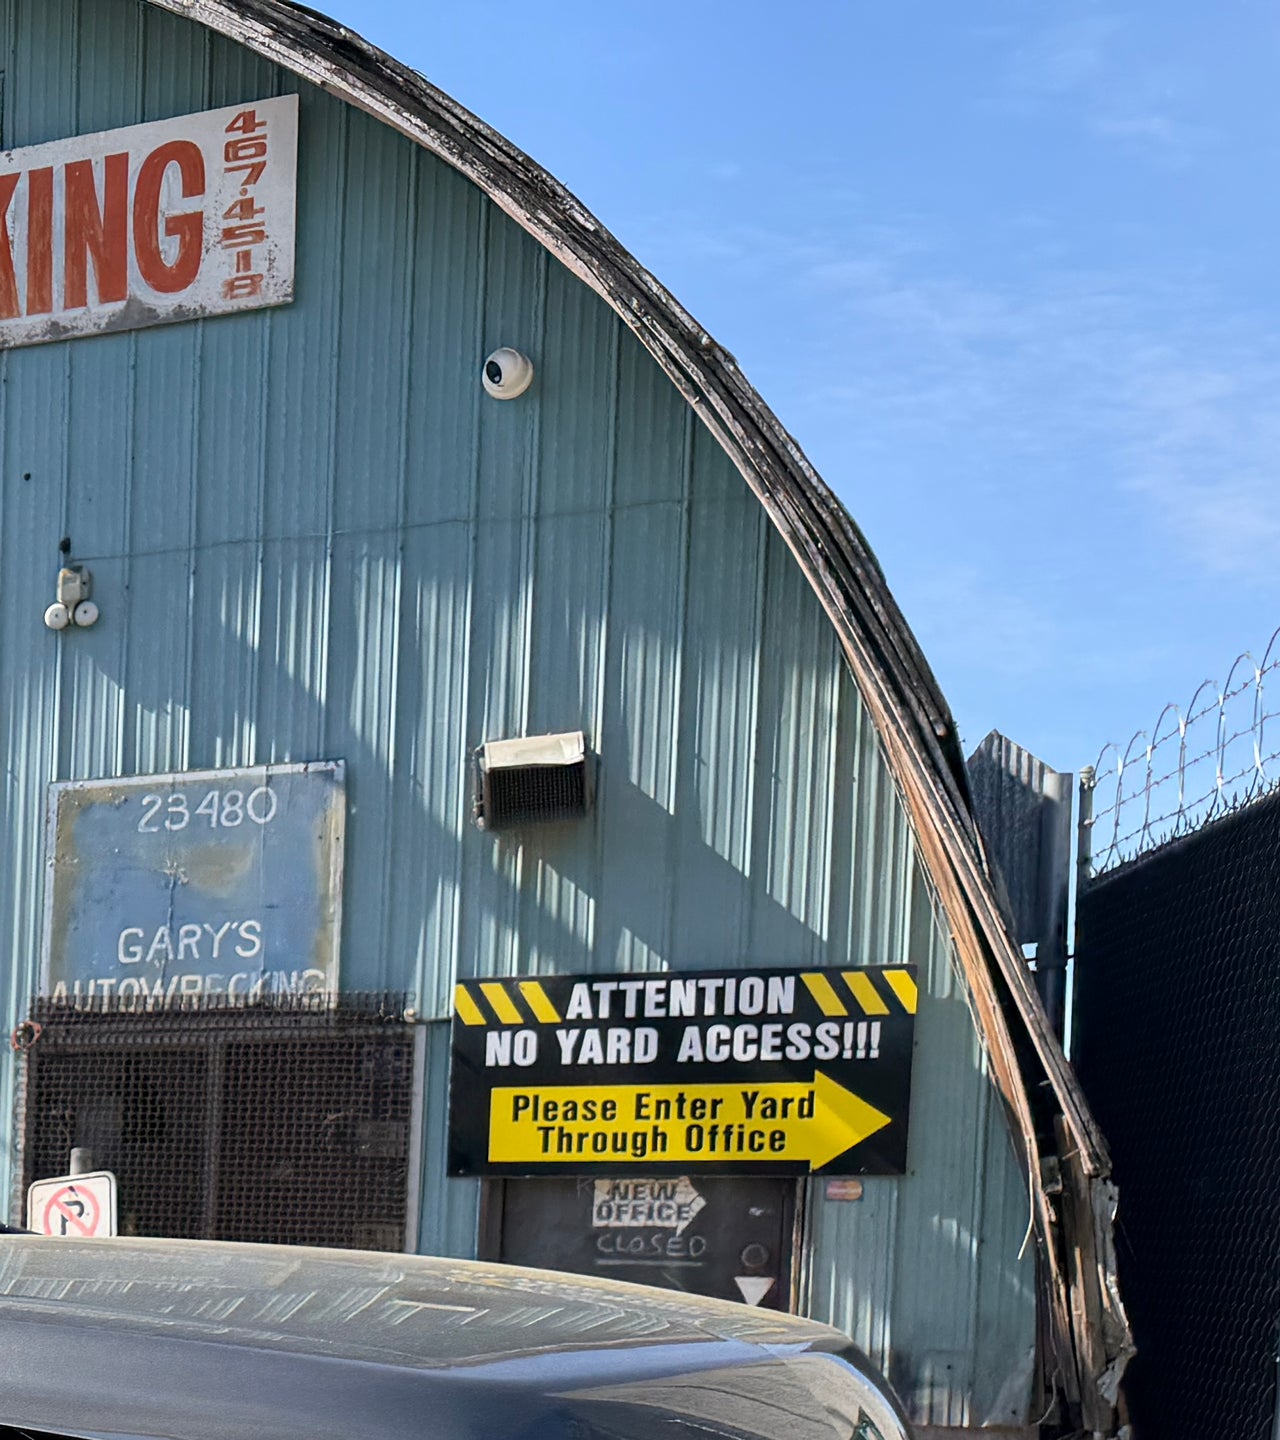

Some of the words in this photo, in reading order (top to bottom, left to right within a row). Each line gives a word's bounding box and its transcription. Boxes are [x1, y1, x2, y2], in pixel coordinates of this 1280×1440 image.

[138, 787, 278, 832] 23480
[118, 920, 261, 964] GARY'S
[566, 976, 795, 1020] ATTENTION
[485, 1030, 537, 1067] NO
[556, 1026, 658, 1064] YARD
[677, 1022, 881, 1062] ACCESS!!!
[512, 1094, 617, 1121] Please
[635, 1093, 723, 1120] Enter
[741, 1091, 815, 1119] Yard
[537, 1126, 668, 1157] Through
[686, 1124, 787, 1152] Office
[611, 1180, 679, 1200] NEW
[596, 1201, 691, 1221] OFFICE
[596, 1233, 706, 1257] CLOSED
